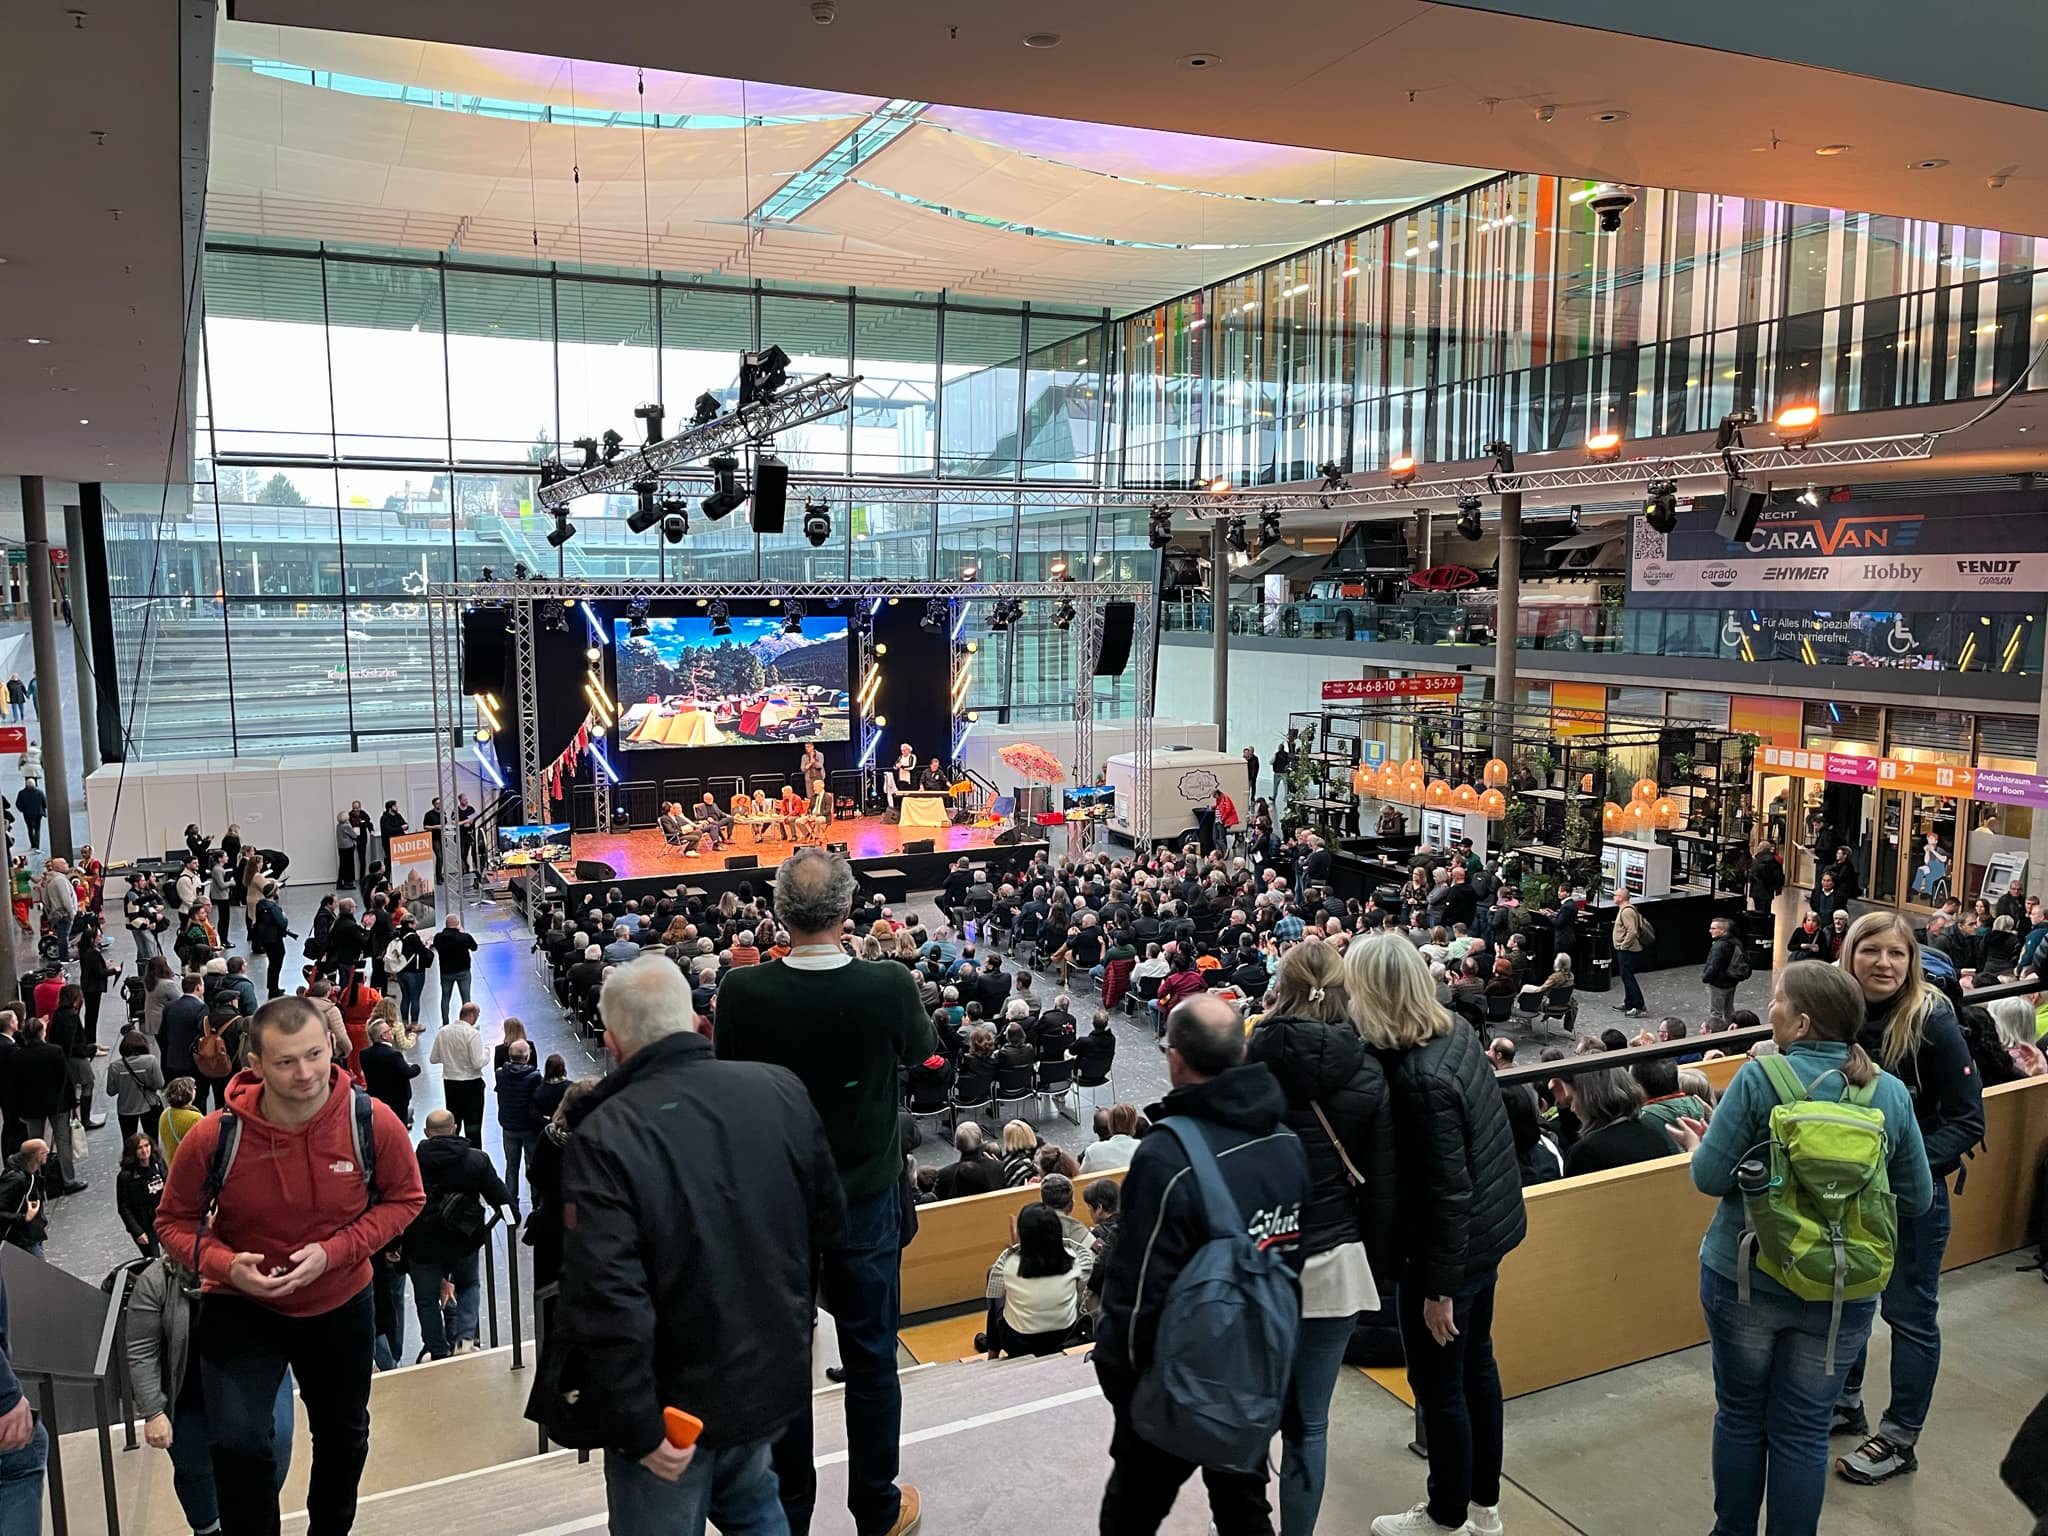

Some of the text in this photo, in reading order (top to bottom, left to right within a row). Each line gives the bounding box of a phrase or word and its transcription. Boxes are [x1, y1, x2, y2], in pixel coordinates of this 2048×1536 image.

[1956, 560, 2021, 573] FENDT
[1700, 567, 1738, 580] carado
[1774, 567, 1829, 580] HYMER
[1863, 563, 1923, 584] Hobby
[1762, 617, 1776, 628] Für
[1778, 617, 1799, 628] Alles
[1773, 630, 1796, 641] Auch
[1977, 772, 2031, 785] Andachtsraum
[1977, 783, 2025, 796] Prayer Room
[393, 838, 430, 855] INDIEN
